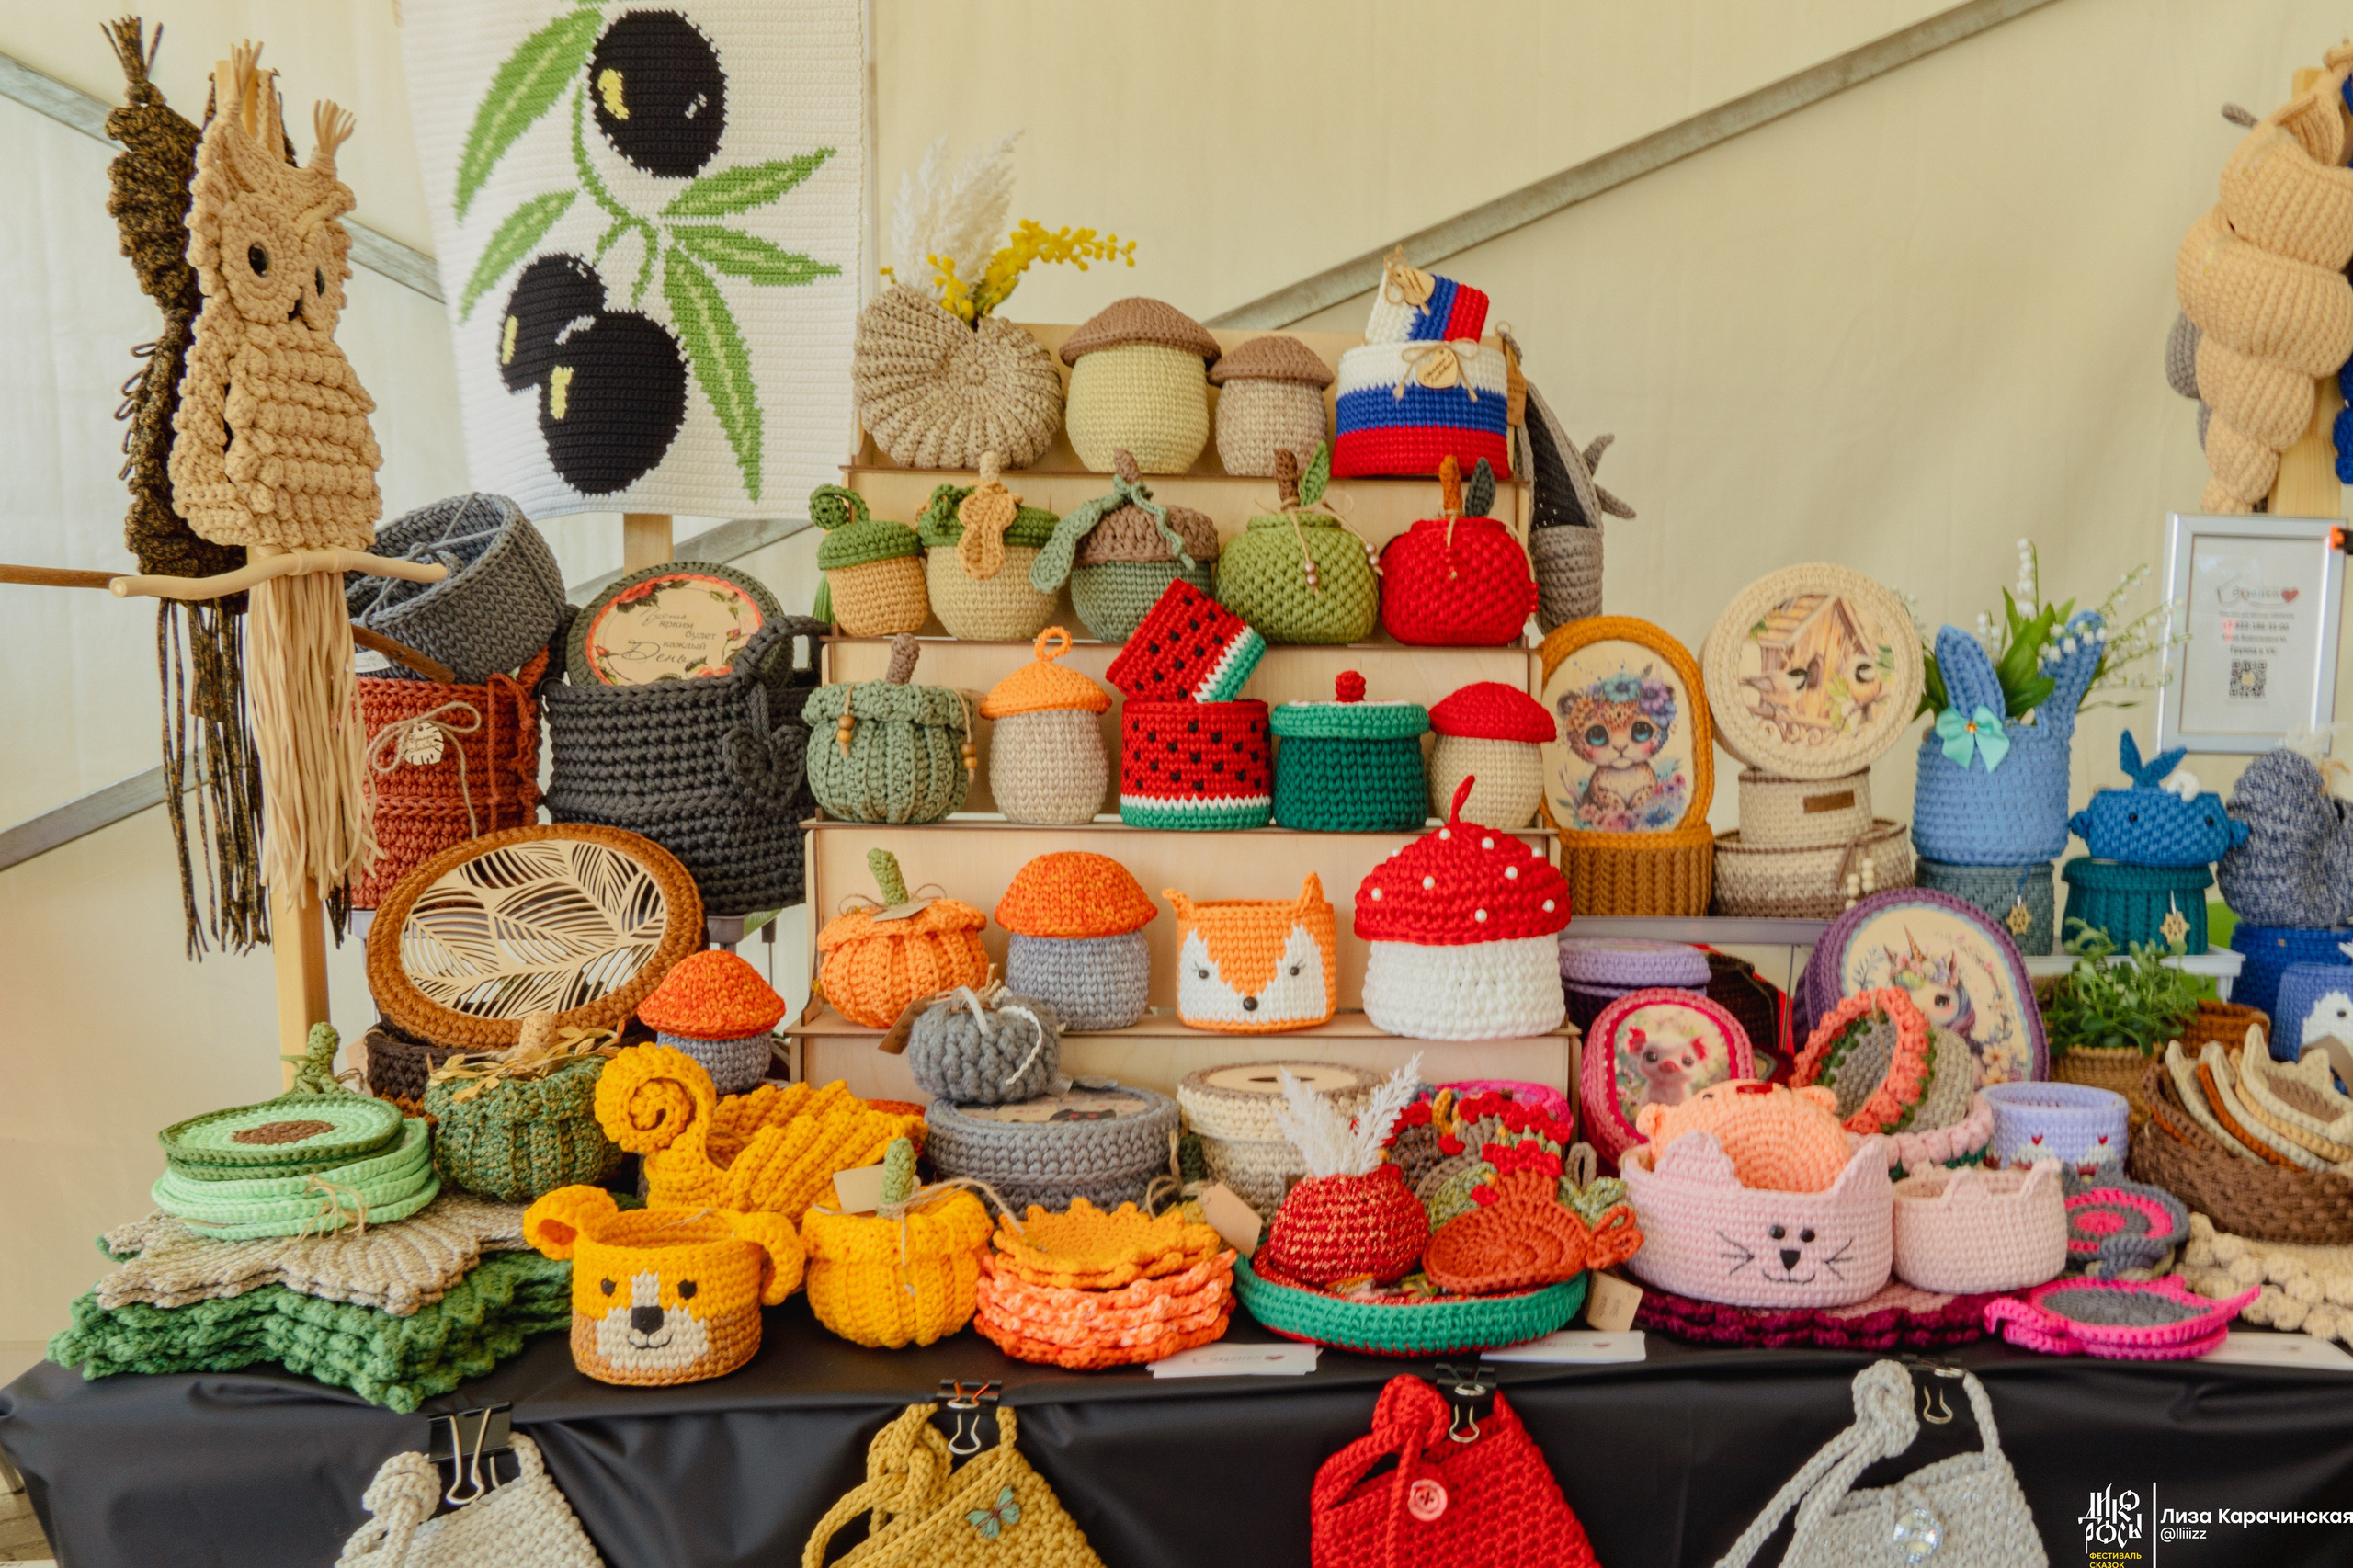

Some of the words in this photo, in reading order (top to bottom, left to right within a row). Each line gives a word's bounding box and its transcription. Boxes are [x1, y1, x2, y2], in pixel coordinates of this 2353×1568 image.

[659, 620, 694, 629] ярким
[685, 631, 716, 641] будет
[622, 640, 687, 662] День
[663, 641, 707, 651] каждый
